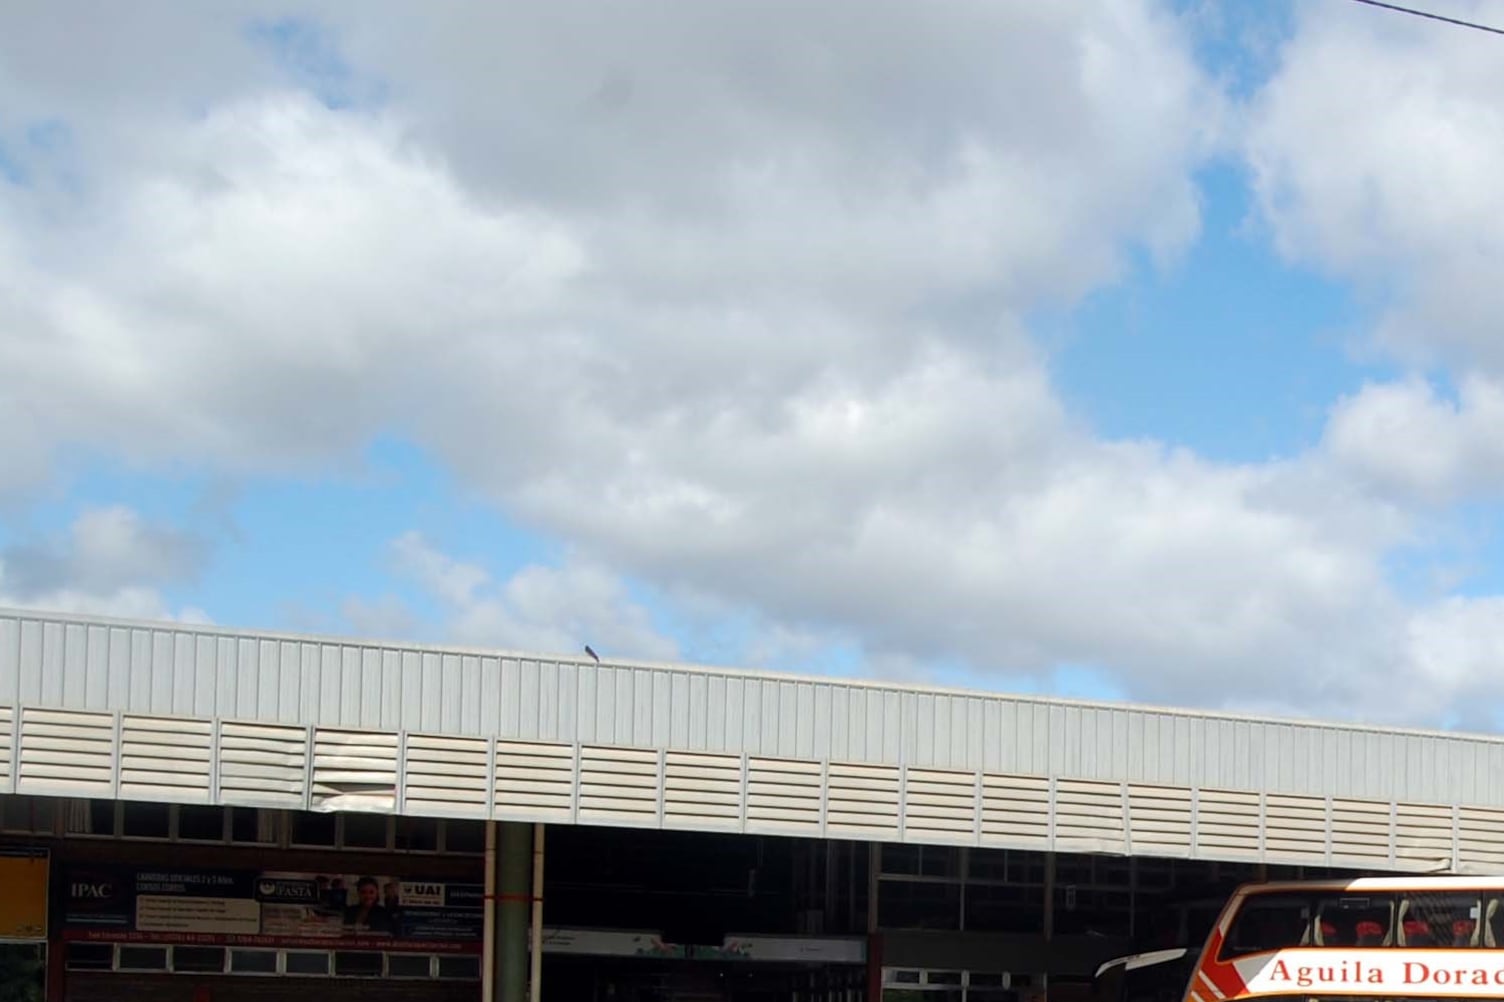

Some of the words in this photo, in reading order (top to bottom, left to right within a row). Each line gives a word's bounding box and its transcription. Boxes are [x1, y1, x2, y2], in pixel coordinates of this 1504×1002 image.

[71, 881, 112, 898] IPAC
[415, 885, 440, 895] UAI
[1270, 960, 1386, 987] Aguila
